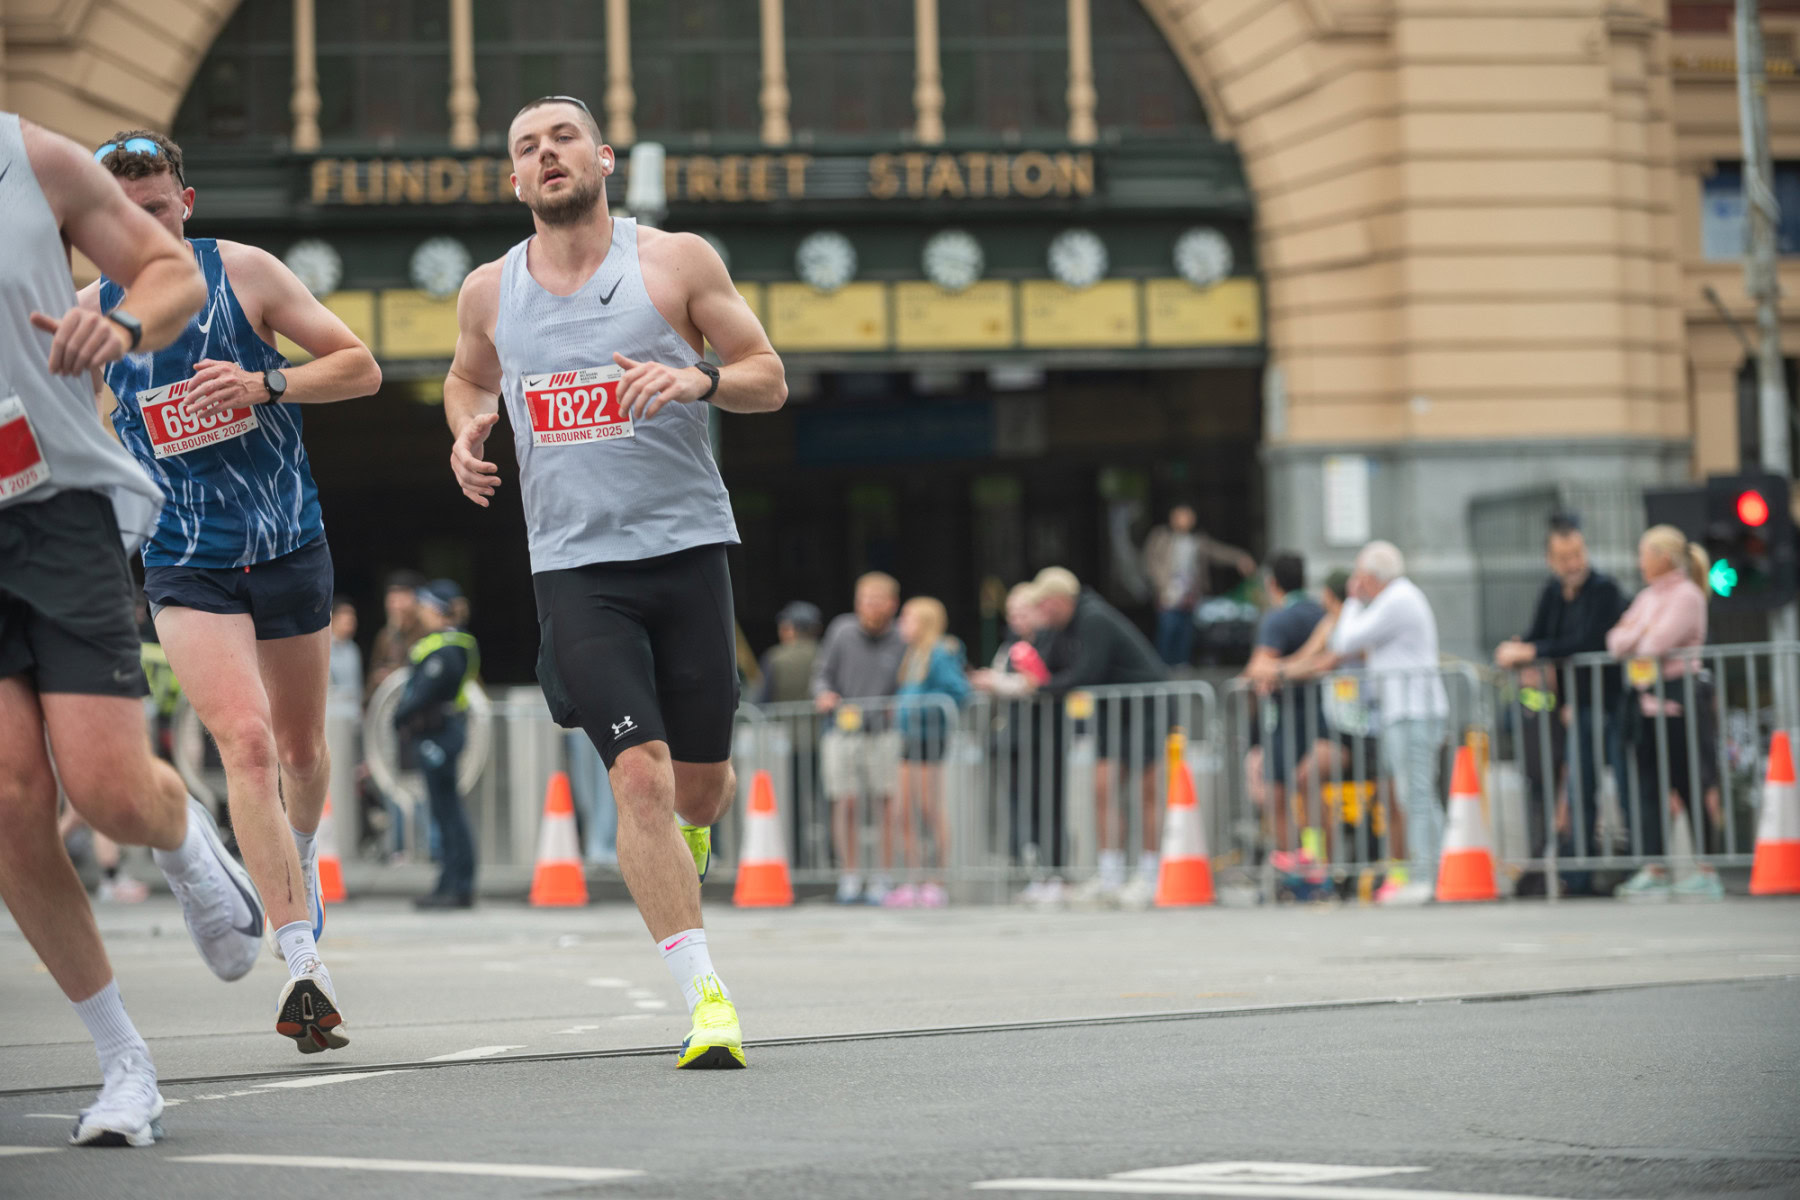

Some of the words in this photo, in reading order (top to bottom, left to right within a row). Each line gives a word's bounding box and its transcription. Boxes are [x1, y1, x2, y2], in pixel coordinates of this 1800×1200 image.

[868, 151, 1095, 199] STATION
[540, 387, 611, 428] 7822
[162, 430, 222, 455] MELBOURNE
[221, 420, 248, 438] 2025
[540, 429, 593, 444] MELBOURNE
[596, 425, 623, 439] 2025
